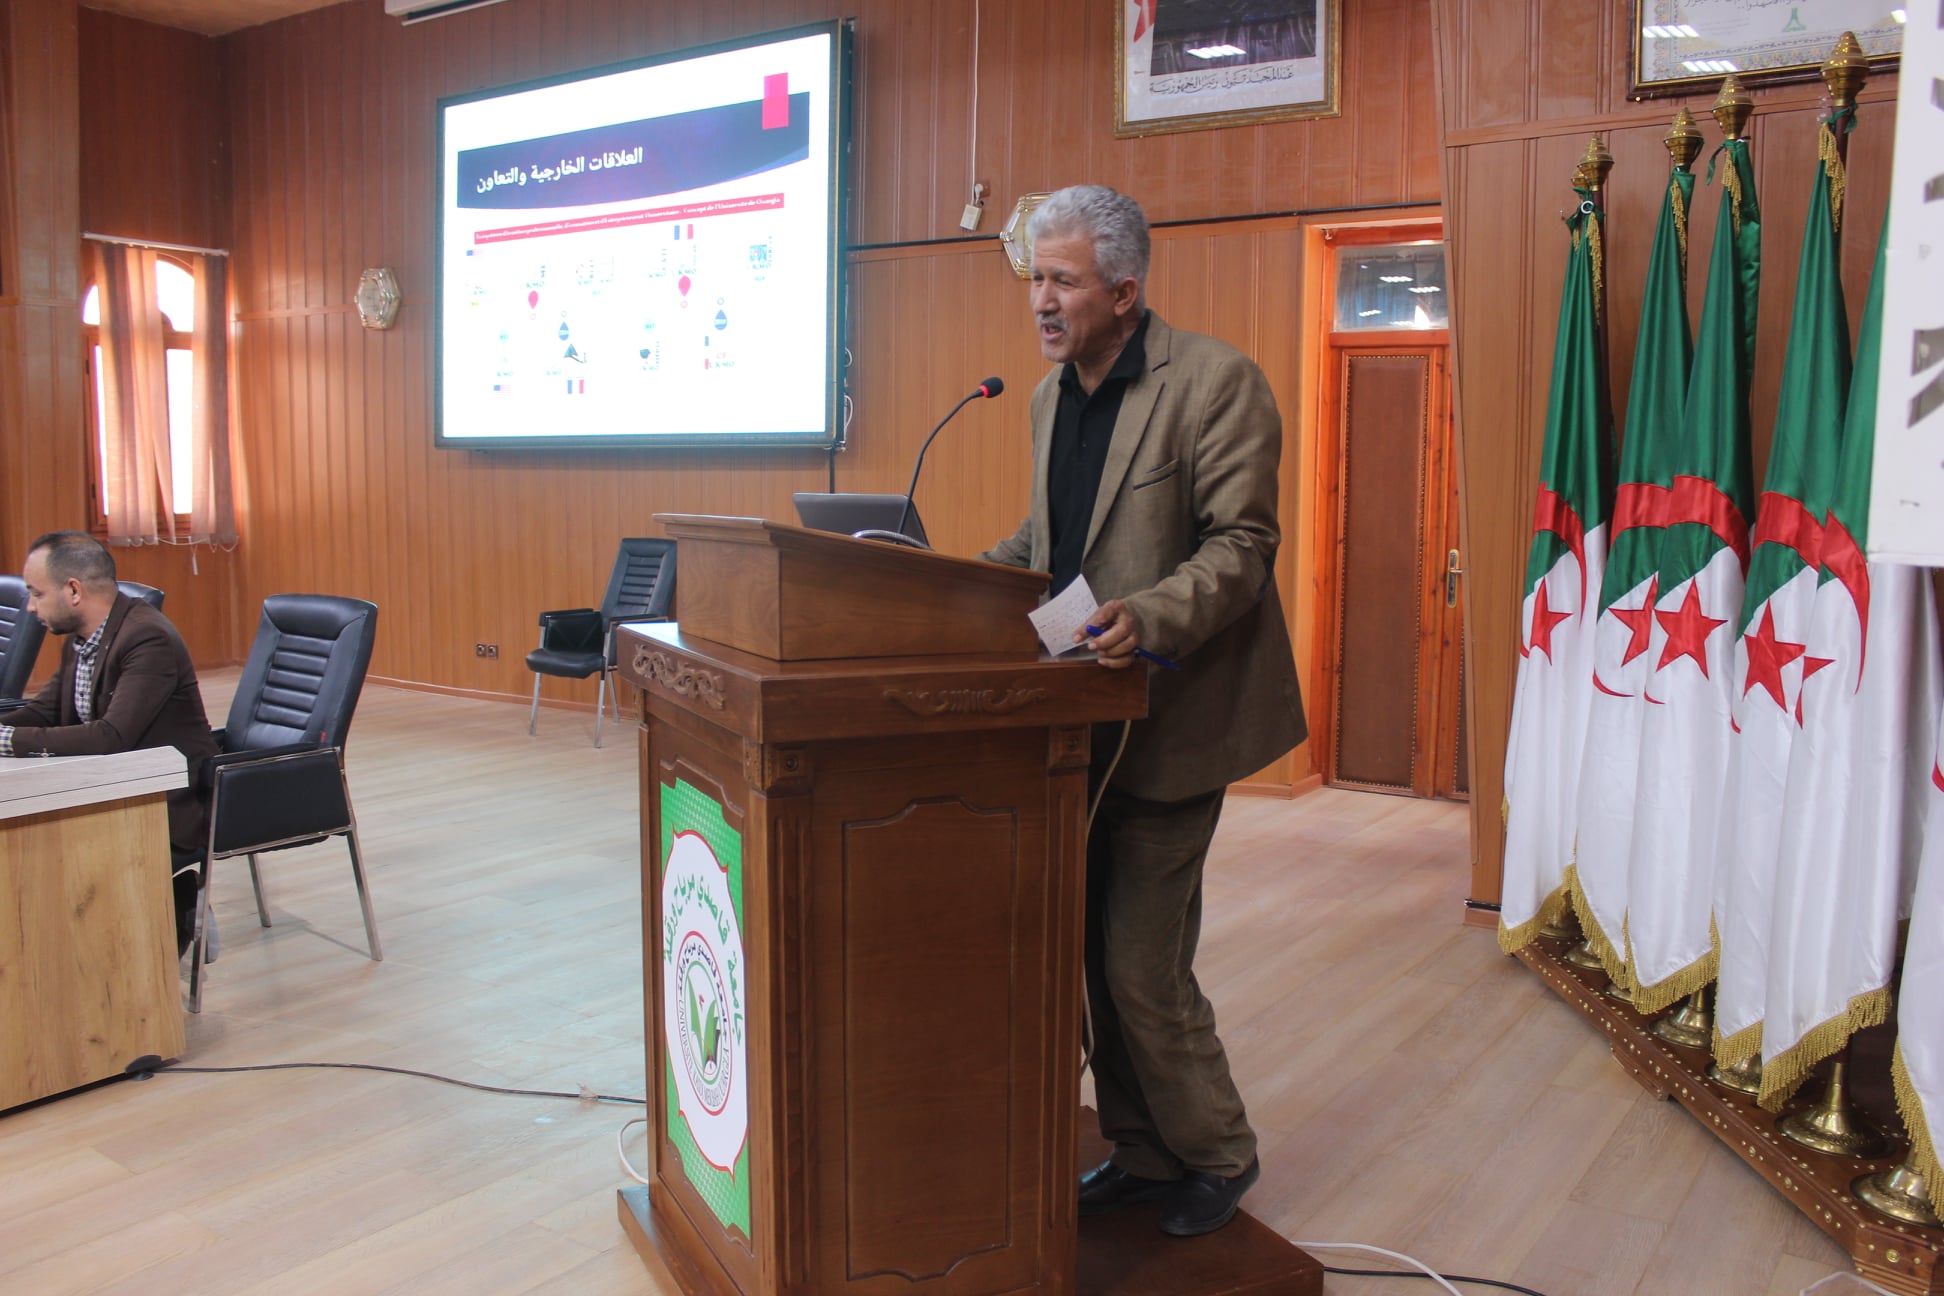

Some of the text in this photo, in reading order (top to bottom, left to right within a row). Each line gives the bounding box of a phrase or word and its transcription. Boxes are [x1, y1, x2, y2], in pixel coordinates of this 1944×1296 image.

[476, 146, 643, 193] العلاقات الخارجية والتعاون
[663, 873, 743, 1047] جامعة قاصدي مرباح ورقلة
